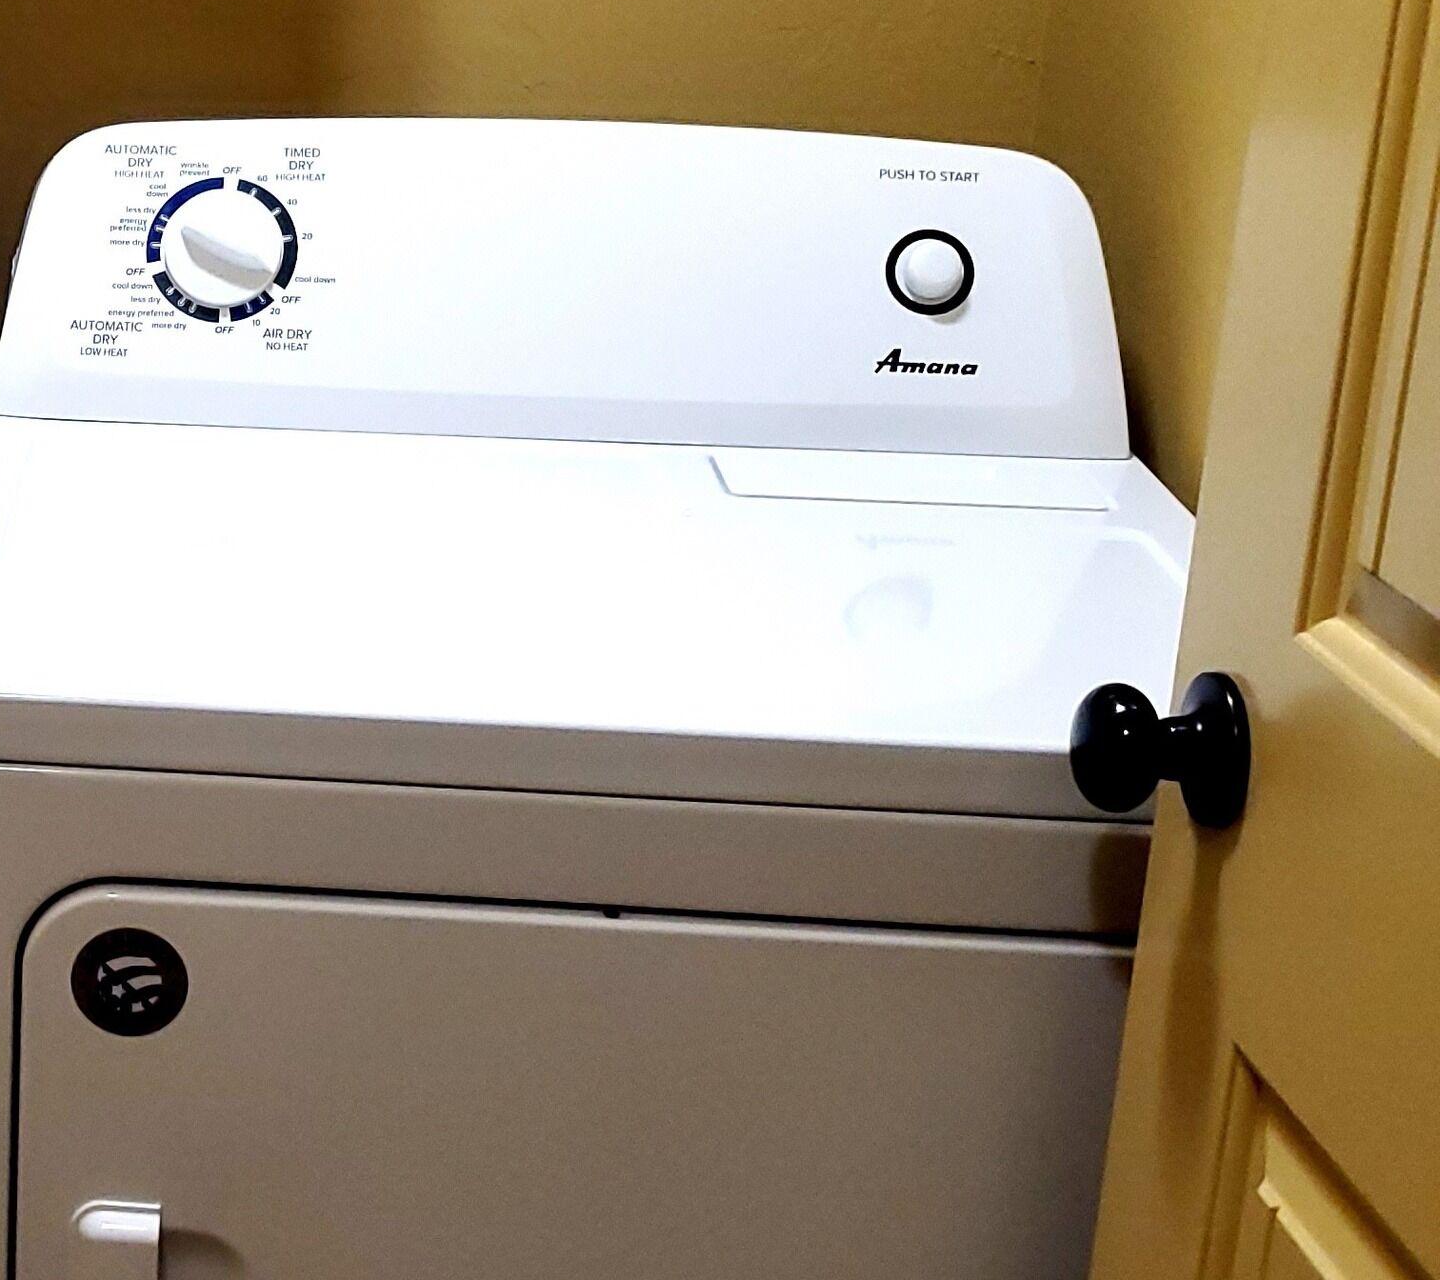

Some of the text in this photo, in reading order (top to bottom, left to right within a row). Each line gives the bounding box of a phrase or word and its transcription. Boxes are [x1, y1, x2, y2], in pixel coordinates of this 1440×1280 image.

[105, 144, 177, 156] AUTOMATIC
[284, 147, 321, 158] TIMED
[128, 158, 153, 167] DRY
[288, 160, 314, 171] DRY
[222, 166, 242, 175] OFF
[879, 168, 980, 183] PUSH TO START
[286, 198, 298, 206] 40
[301, 232, 313, 240] 20
[132, 239, 145, 247] dry
[125, 267, 146, 276] OFF
[148, 296, 161, 304] dry
[281, 295, 301, 304] OFF
[269, 307, 281, 315] 20
[70, 319, 143, 332] AUTOMATIC
[173, 322, 187, 331] dry
[252, 319, 261, 327] 10
[214, 326, 235, 334] OFF
[262, 328, 312, 340] AIR DRY
[92, 333, 119, 345] DRY
[265, 341, 308, 351] NO HEAT
[80, 346, 128, 357] LOW HEAT
[874, 348, 979, 376] Amana
